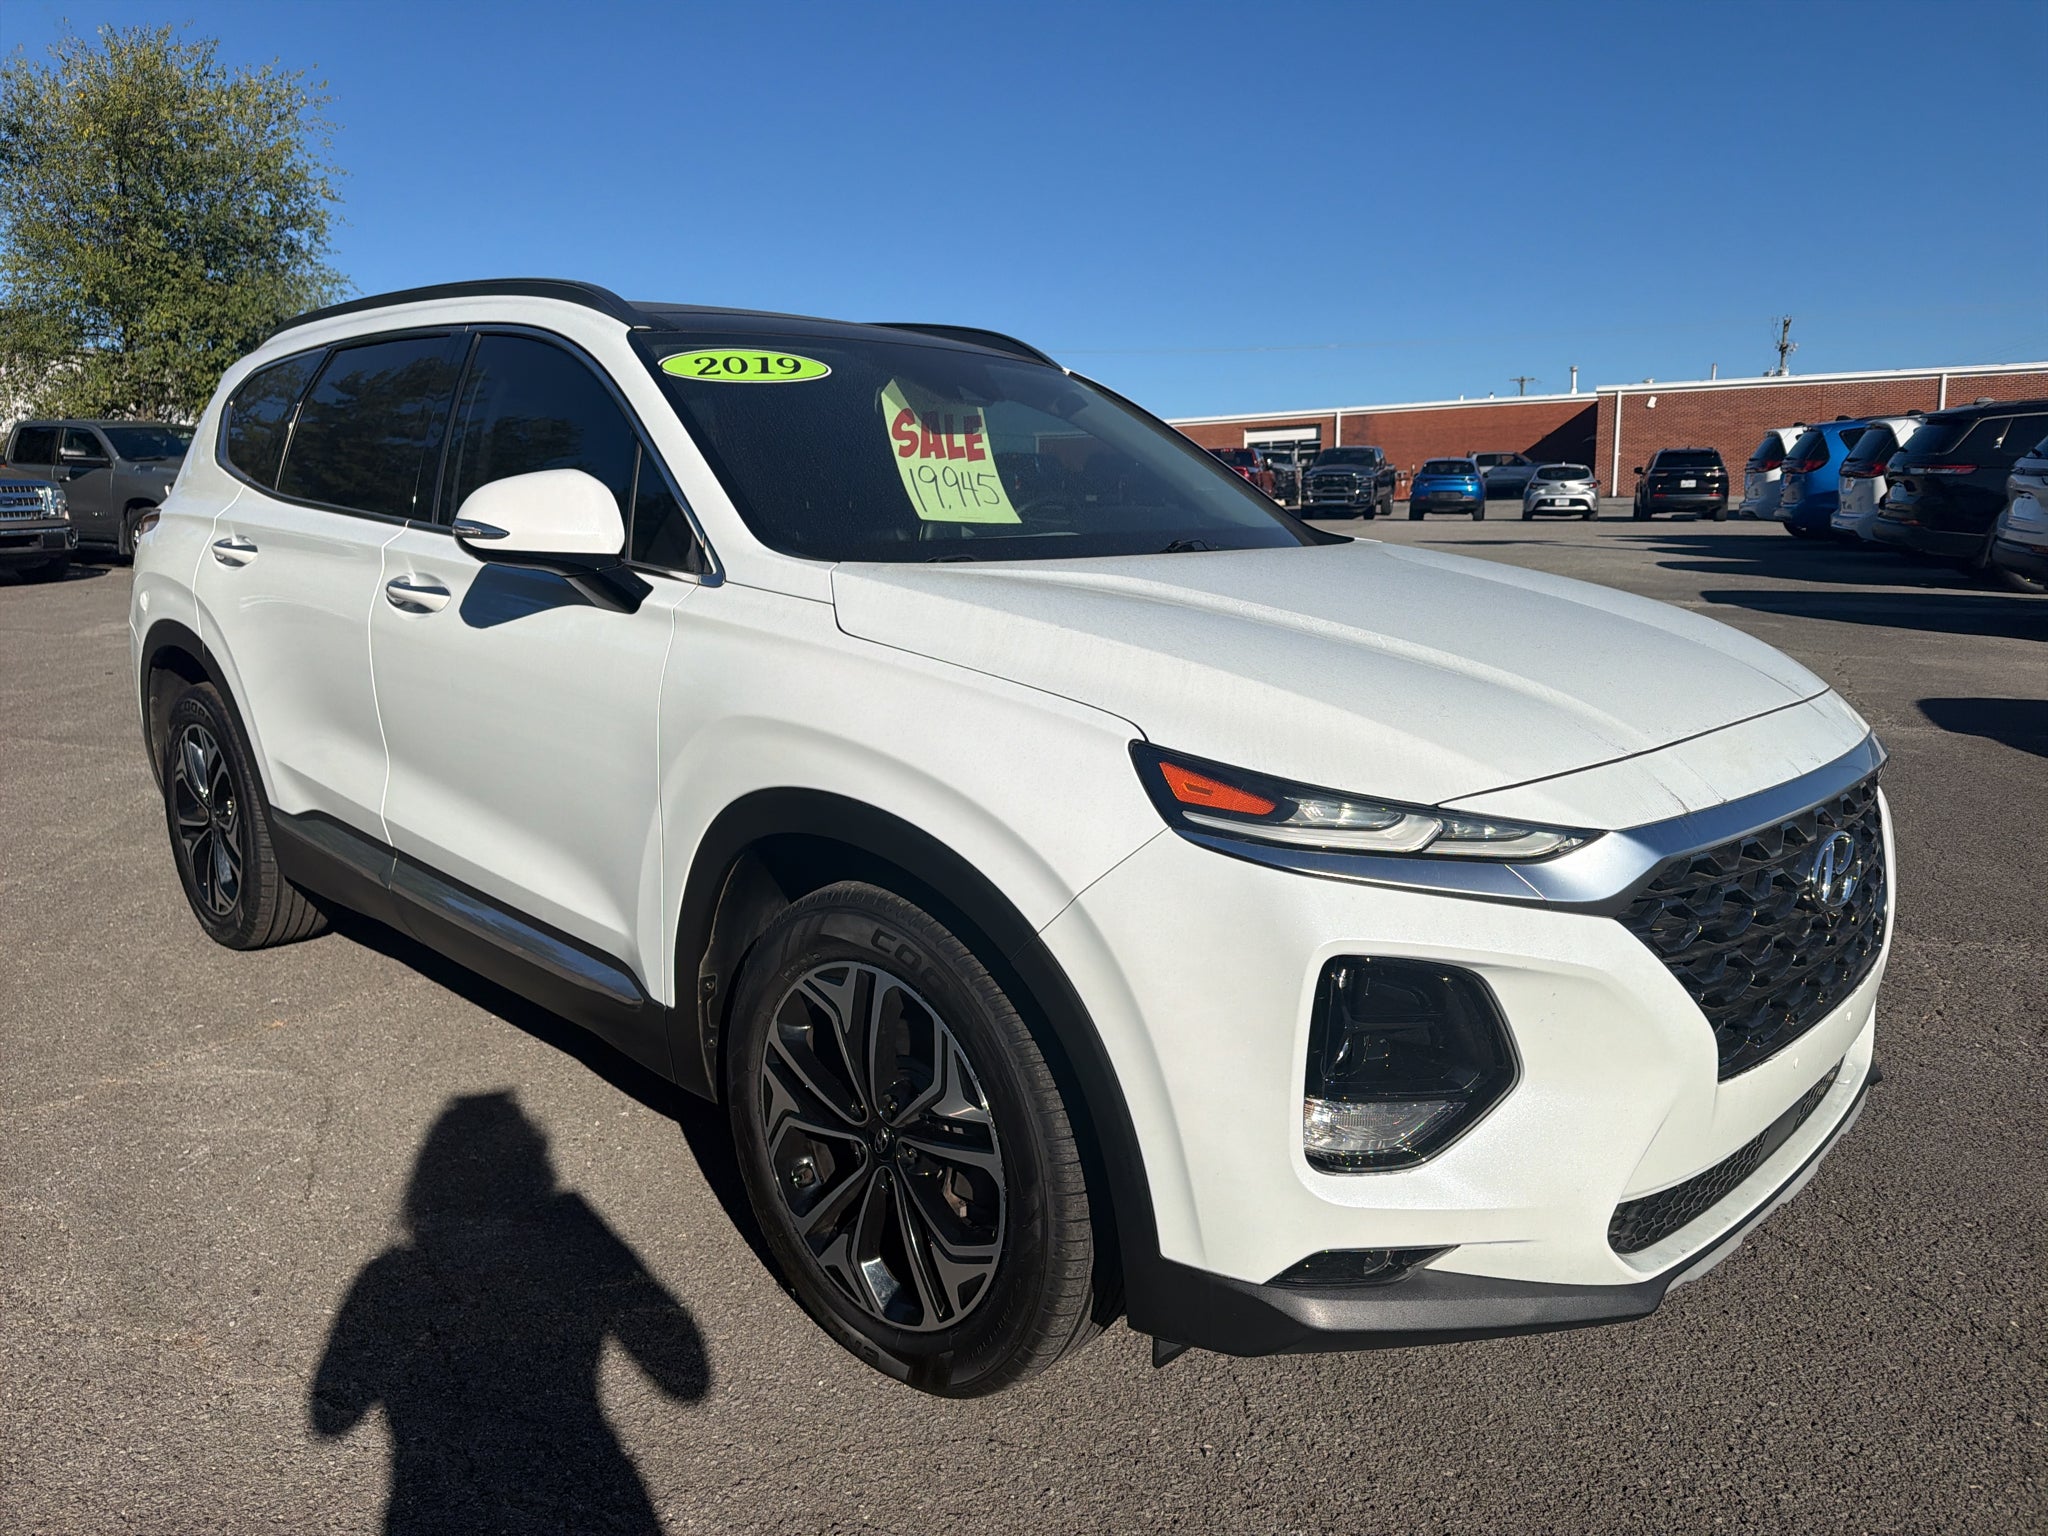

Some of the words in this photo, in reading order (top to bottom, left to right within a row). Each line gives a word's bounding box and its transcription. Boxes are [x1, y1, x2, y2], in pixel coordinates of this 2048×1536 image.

[694, 356, 802, 375] 2019
[891, 407, 986, 462] SALE
[909, 465, 1000, 513] 19,945
